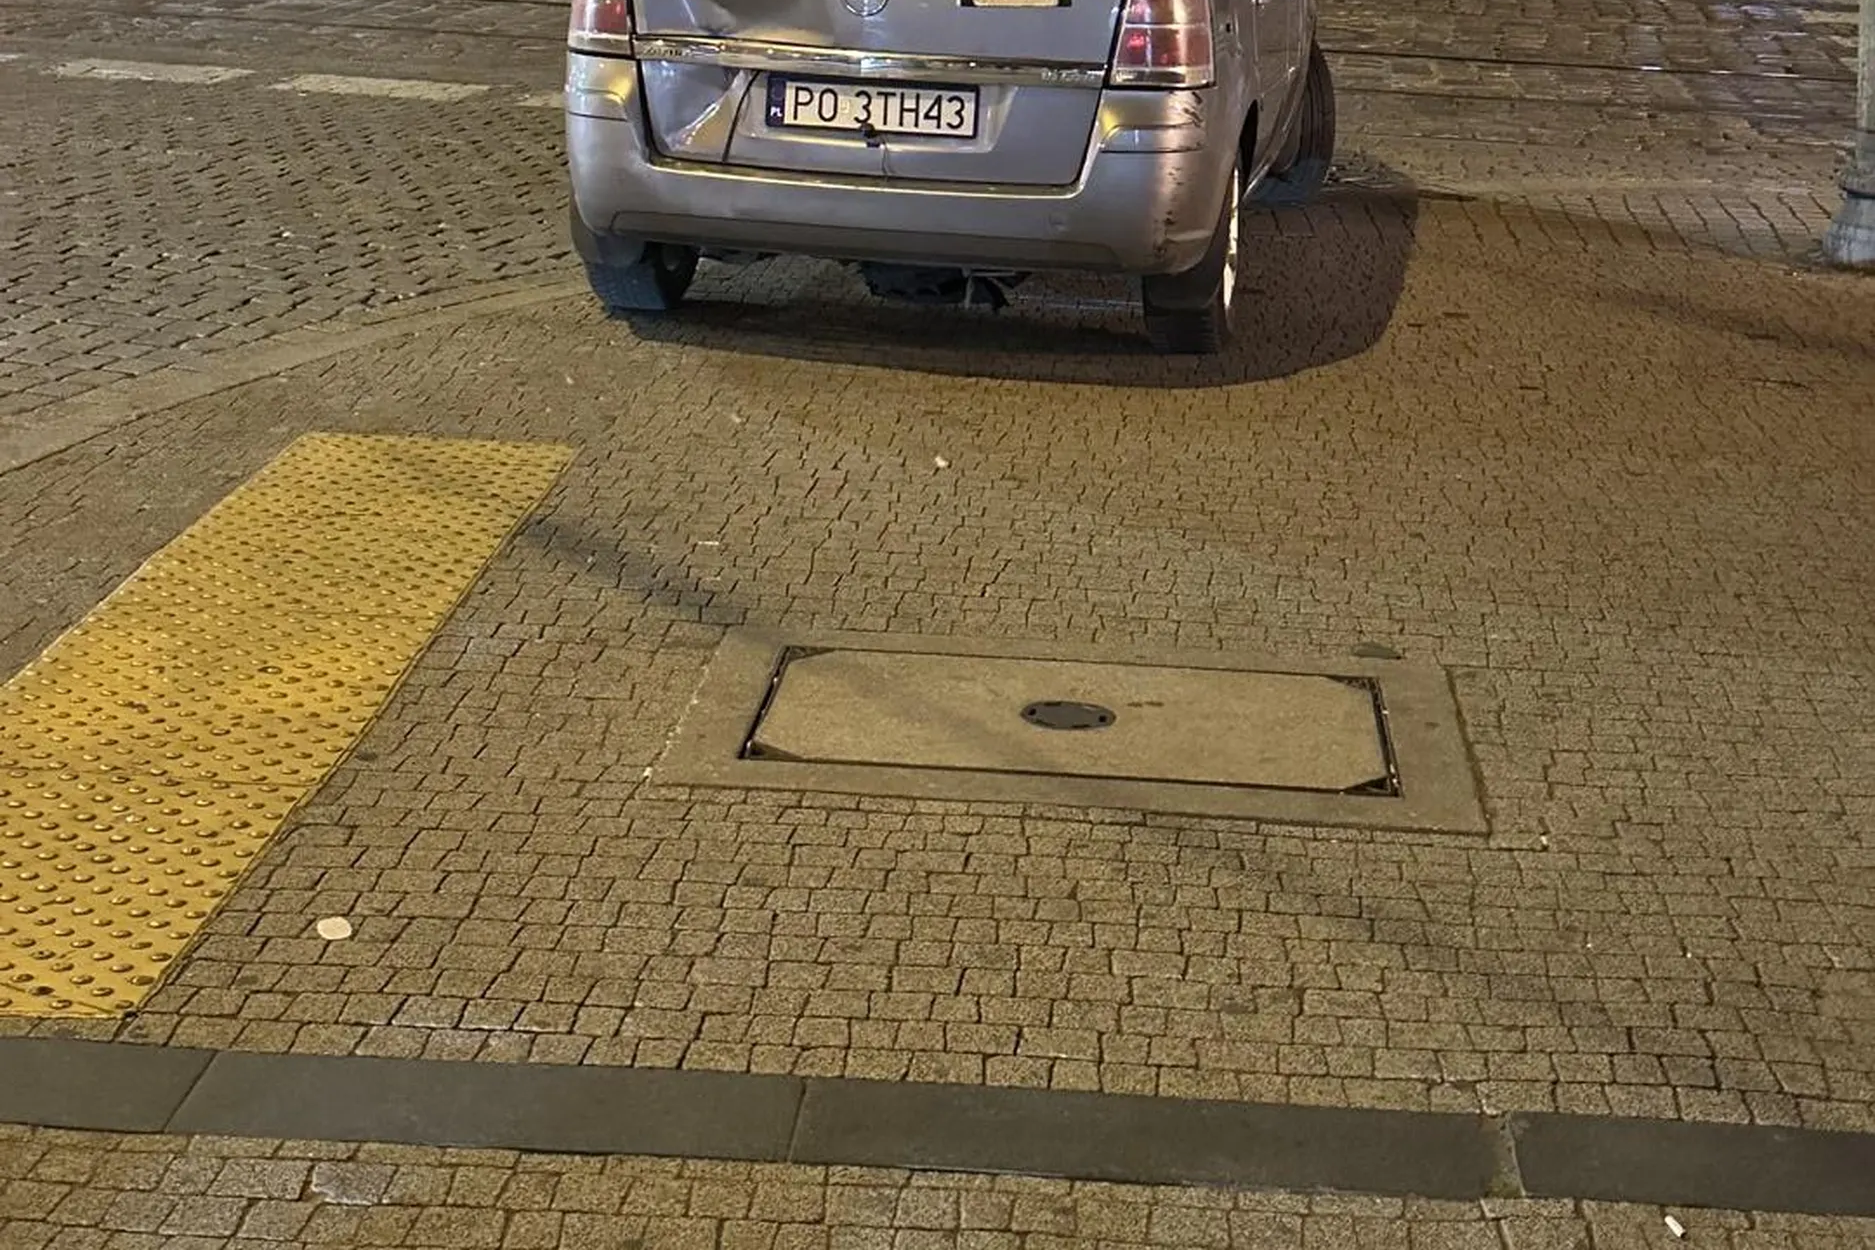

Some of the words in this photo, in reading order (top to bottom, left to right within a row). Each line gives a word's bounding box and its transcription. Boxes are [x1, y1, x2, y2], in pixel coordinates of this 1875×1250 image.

[770, 106, 783, 118] PL
[793, 85, 838, 123] PO
[853, 89, 966, 130] 3TH43
